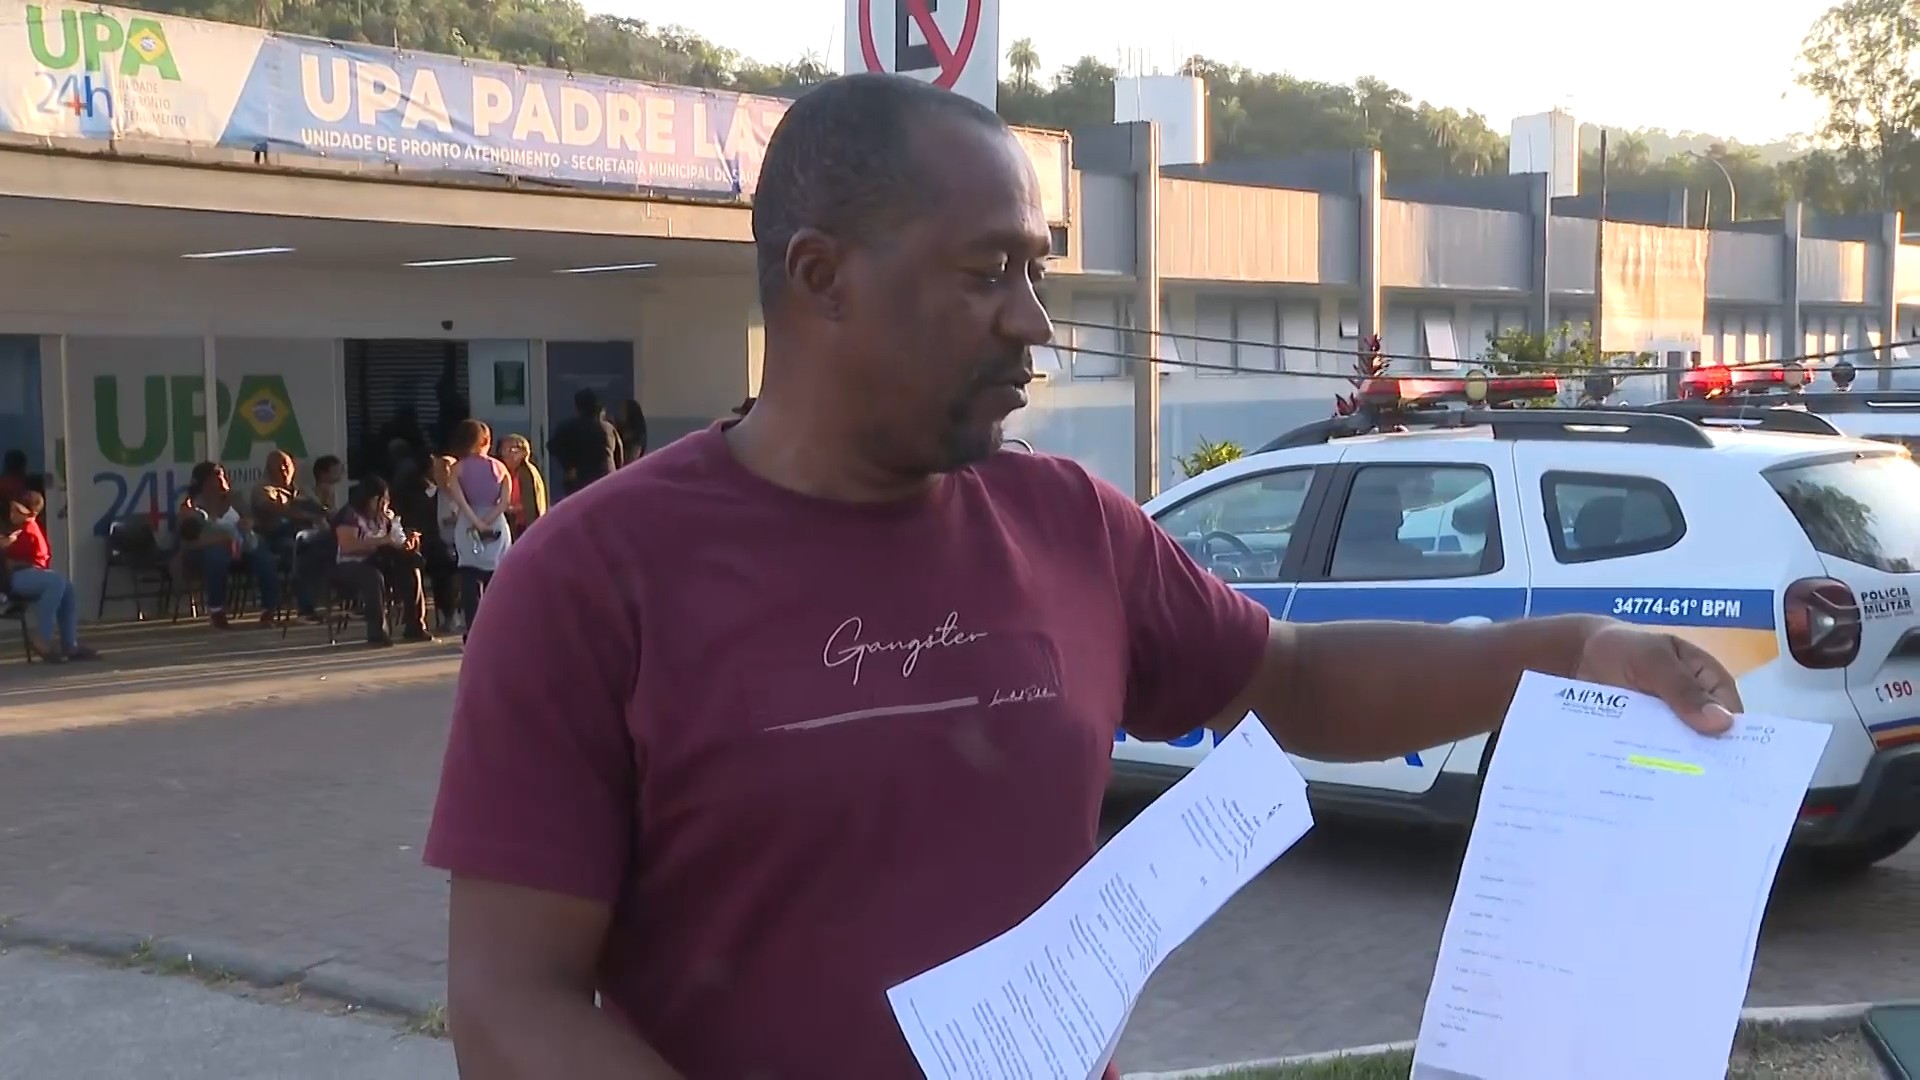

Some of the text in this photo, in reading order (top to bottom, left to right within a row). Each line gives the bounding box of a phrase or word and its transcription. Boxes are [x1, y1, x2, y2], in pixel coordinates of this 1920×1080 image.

[26, 4, 182, 81] UPA
[35, 73, 114, 118] 24h
[118, 79, 159, 94] UNDADE
[301, 53, 453, 133] UPA
[472, 75, 676, 154] PADRE
[301, 128, 372, 150] UNIDADE
[377, 136, 397, 153] DE
[401, 139, 461, 158] PRONTO
[464, 144, 560, 168] ATENDIMENTO
[649, 162, 712, 181] MUNICIPAL
[93, 374, 309, 466] UPA
[1701, 599, 1741, 617] BPM
[1863, 599, 1912, 614] MILITAR
[823, 611, 988, 685] Gangster
[1884, 680, 1913, 699] 190
